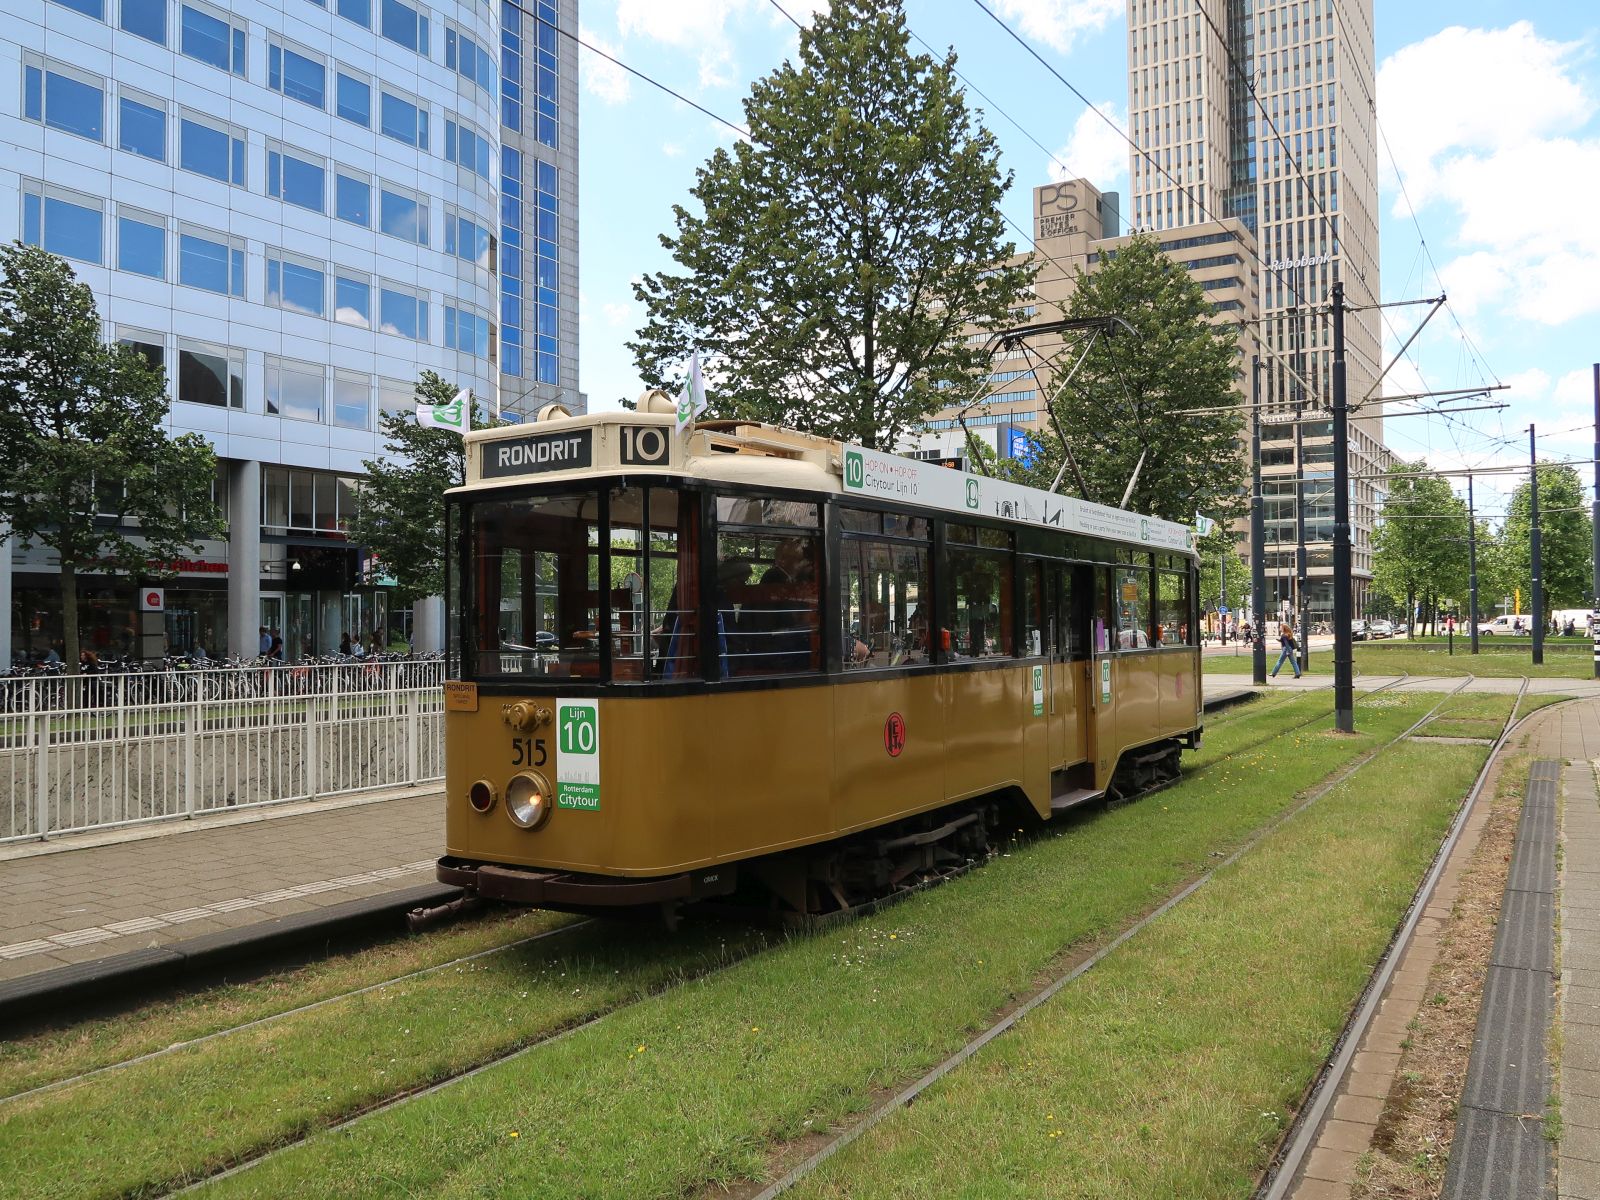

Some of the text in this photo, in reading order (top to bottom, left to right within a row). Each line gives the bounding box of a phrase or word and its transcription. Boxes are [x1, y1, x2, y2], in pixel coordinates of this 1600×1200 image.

[1039, 182, 1078, 215] PS
[1040, 213, 1075, 224] PREMIER
[1040, 221, 1070, 231] SUITES
[1046, 225, 1078, 237] OFFICES
[1270, 252, 1332, 271] Rabobank
[623, 427, 665, 461] 10
[498, 437, 582, 467] RONDRIT
[847, 457, 862, 483] 10
[865, 459, 878, 472] HOP
[865, 473, 895, 491] Citytour
[446, 684, 475, 692] RONDRIT
[1034, 675, 1042, 690] 10
[569, 707, 586, 720] Lijn
[564, 721, 594, 751] 10
[512, 738, 547, 766] 515
[563, 784, 594, 793] Rotterdam
[559, 793, 598, 807] Citytour
